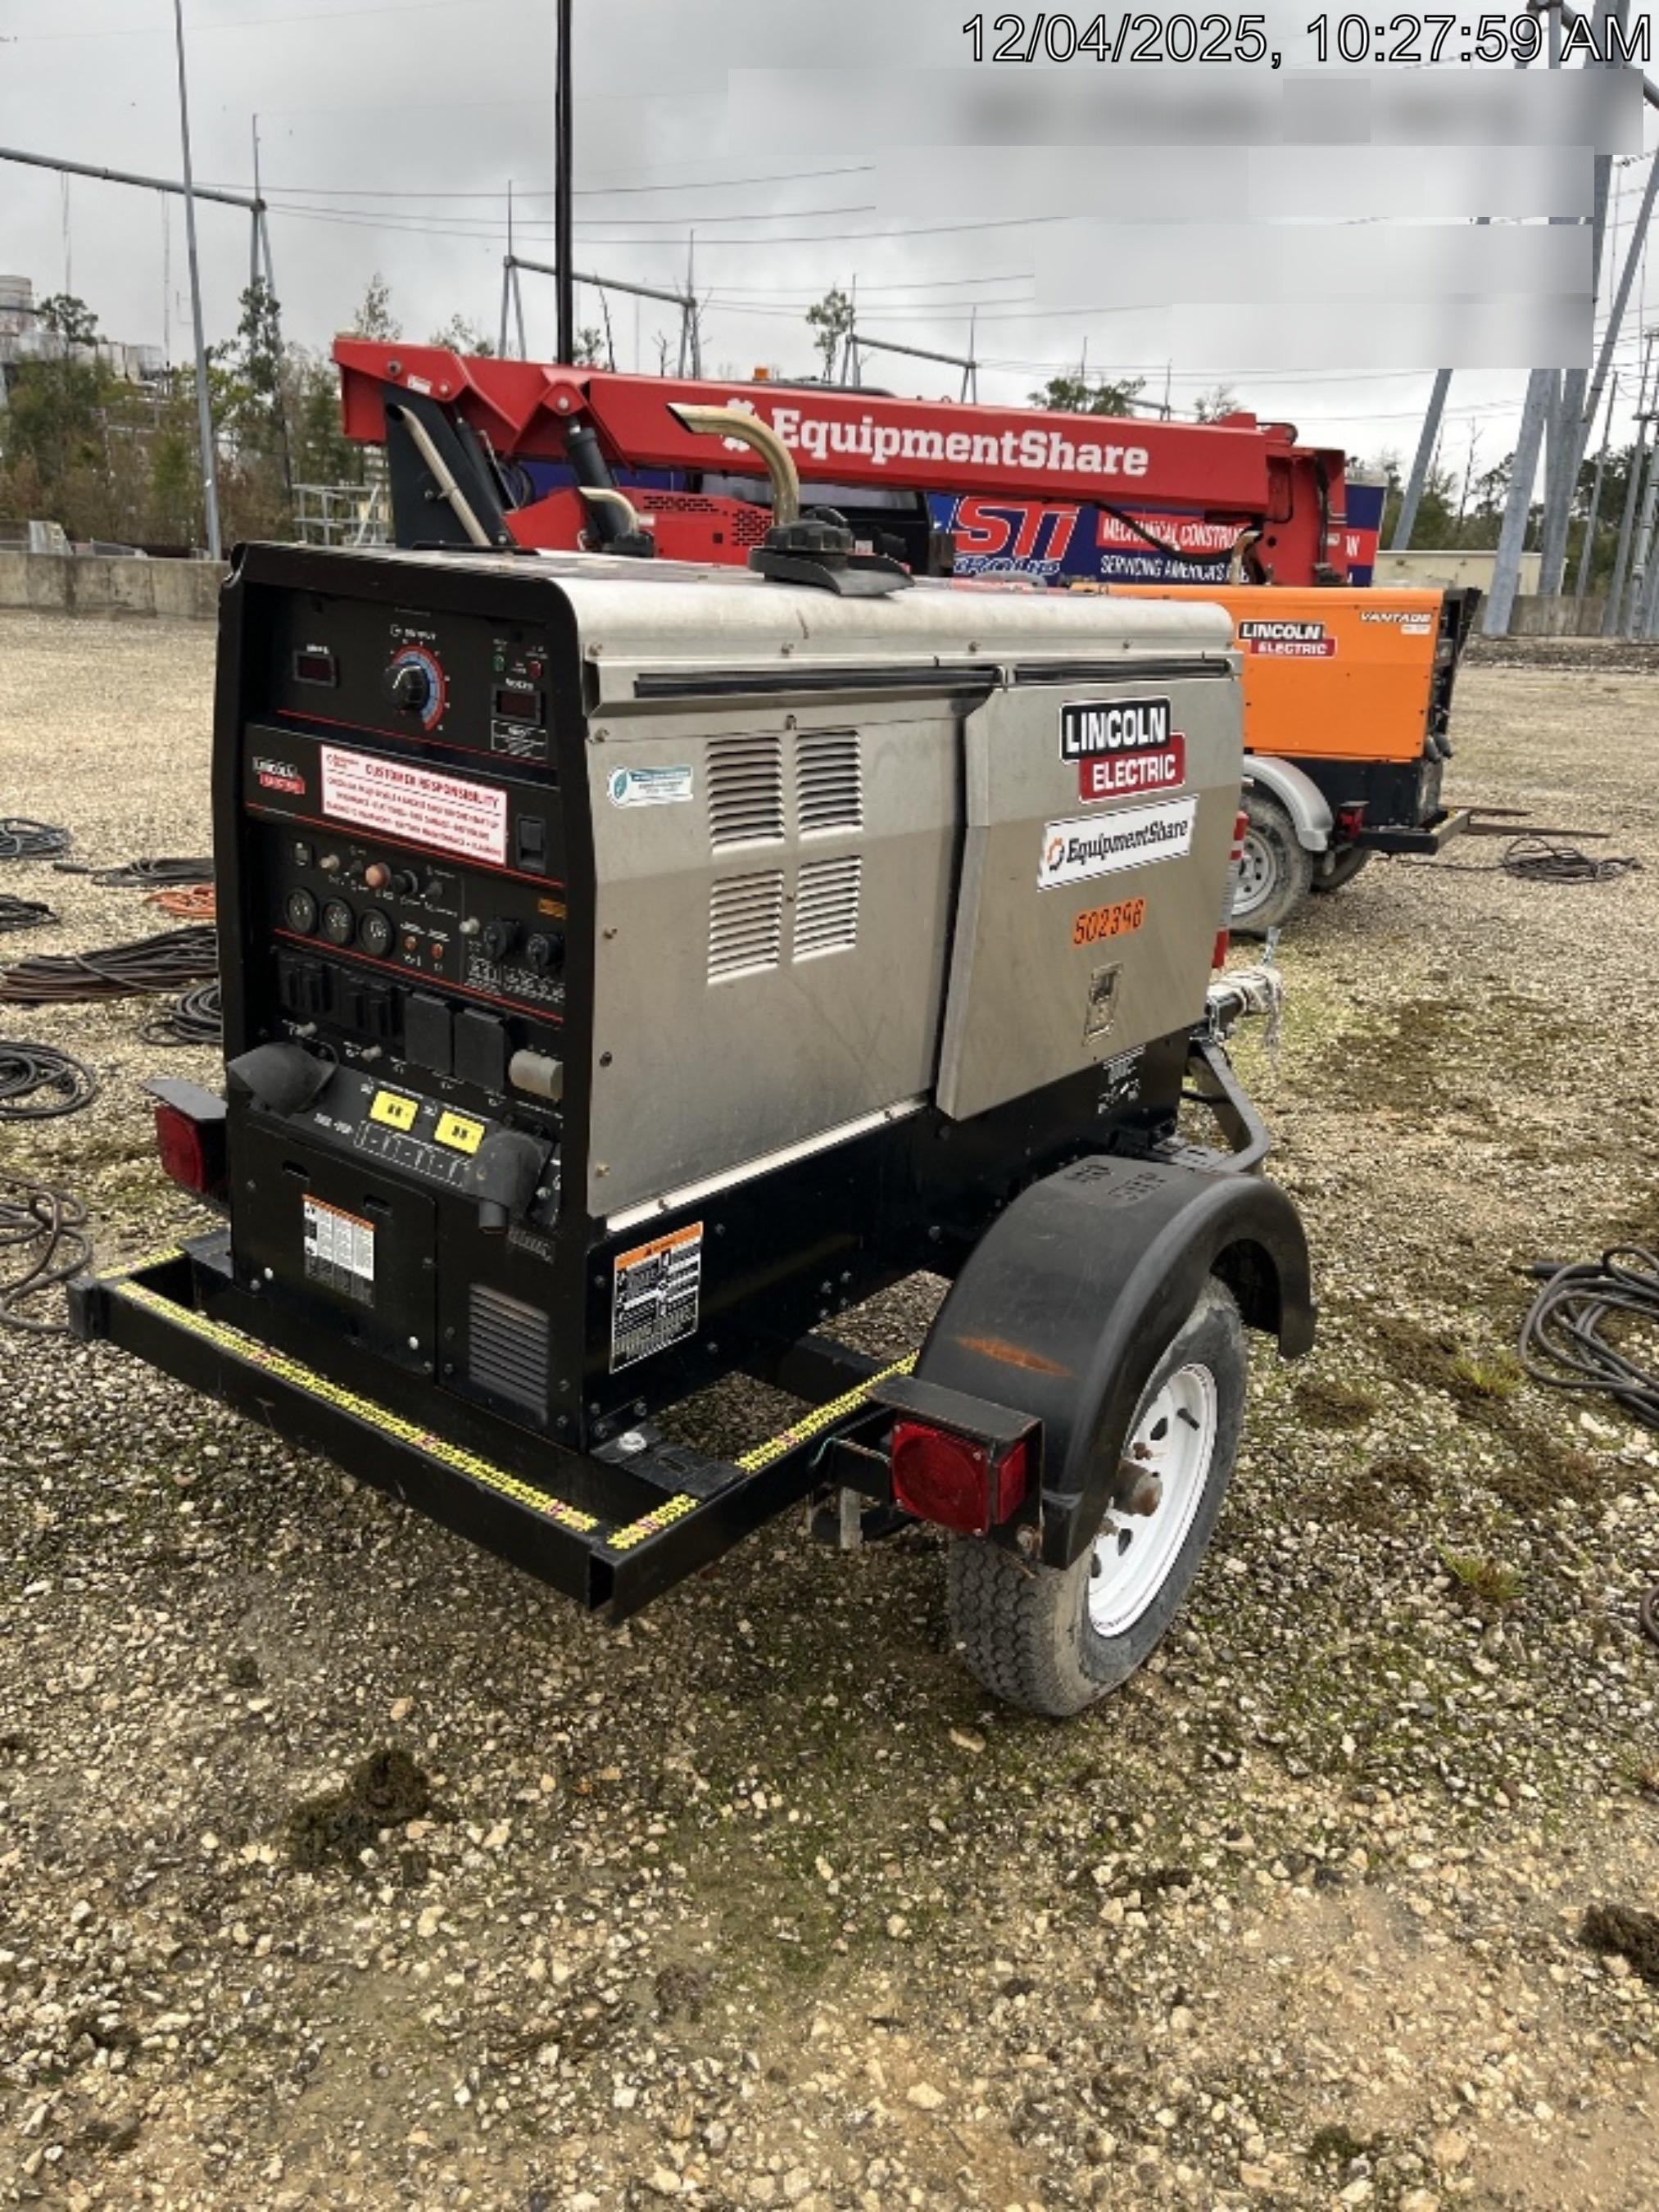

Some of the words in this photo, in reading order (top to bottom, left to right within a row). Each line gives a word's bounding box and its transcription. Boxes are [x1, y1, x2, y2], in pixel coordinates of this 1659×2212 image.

[772, 407, 1149, 477] EquipmentShare
[1242, 623, 1322, 641] LINCOLN
[1258, 641, 1328, 655] ELECTRIC
[1066, 707, 1167, 753] LINCOLN
[1092, 753, 1176, 792] ELECTRIC
[1066, 820, 1188, 866] EquipmentShare
